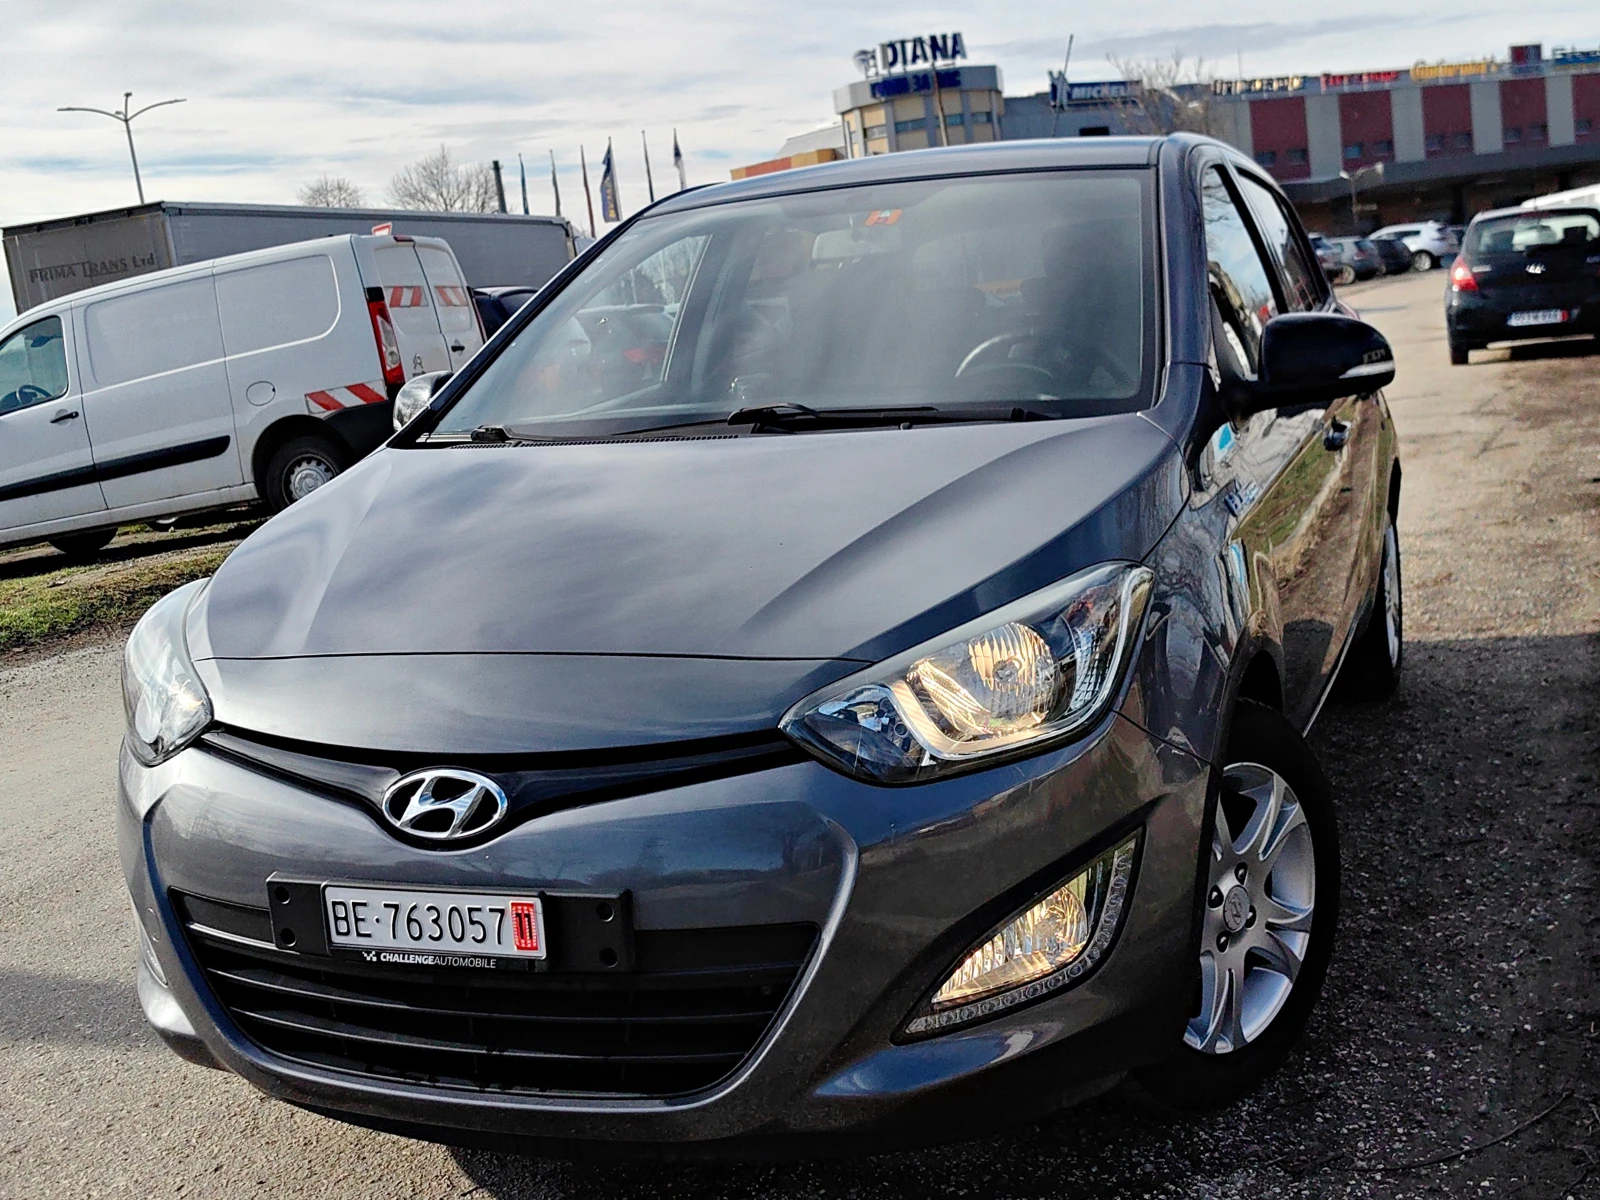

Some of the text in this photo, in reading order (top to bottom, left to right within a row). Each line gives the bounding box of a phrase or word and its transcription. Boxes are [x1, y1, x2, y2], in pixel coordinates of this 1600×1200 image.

[879, 32, 967, 70] DIANA
[29, 252, 155, 284] PRIMA TRANS Ltd
